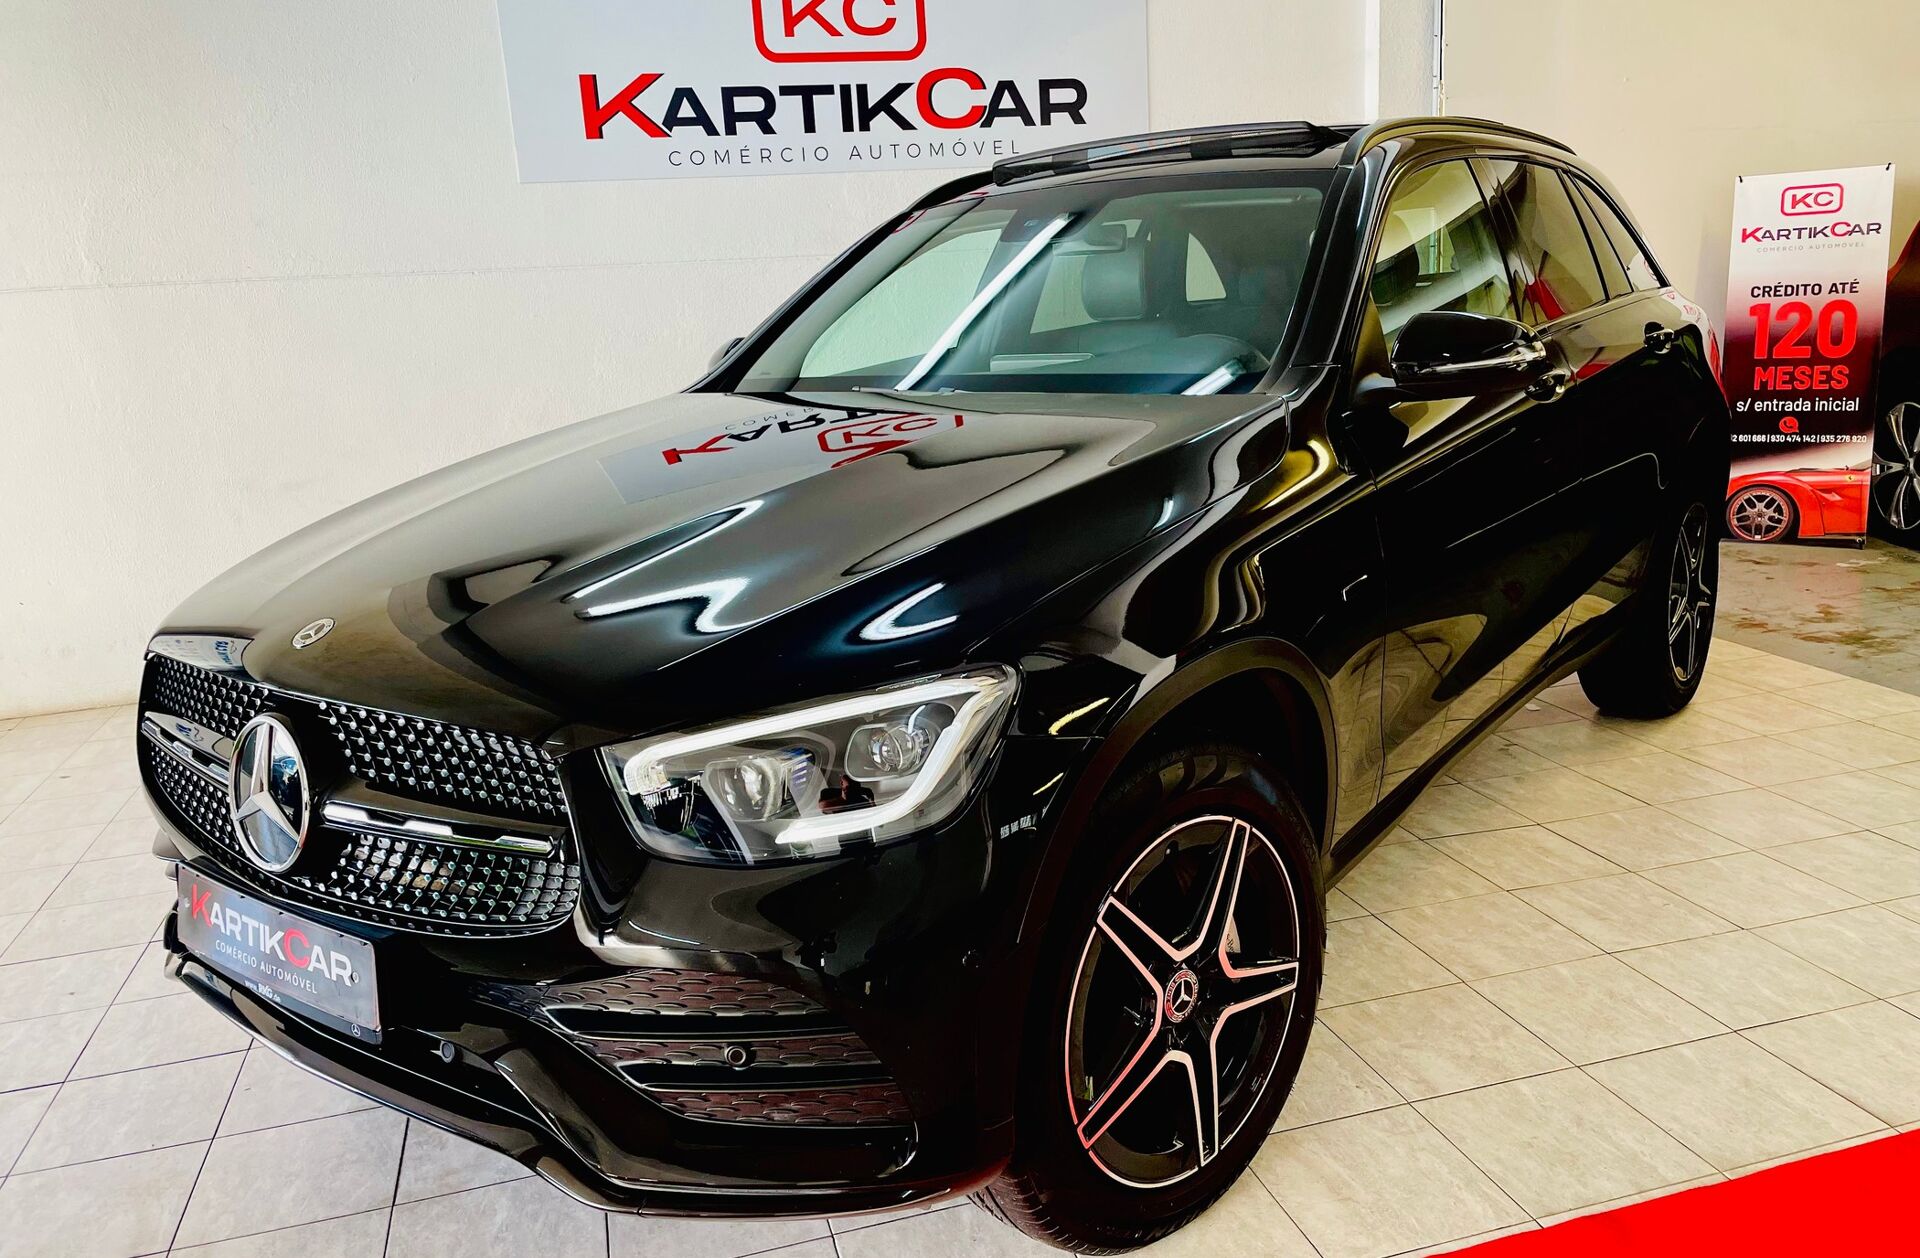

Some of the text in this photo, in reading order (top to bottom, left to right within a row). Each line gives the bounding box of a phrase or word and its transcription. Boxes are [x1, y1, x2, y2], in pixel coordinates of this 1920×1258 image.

[782, 0, 899, 38] KC
[578, 68, 1088, 140] KARTIKCAR
[668, 138, 1020, 166] COMÉRCIO AUTOMÓVEL
[1791, 191, 1834, 209] KC
[1741, 221, 1882, 243] KARTIKCAR
[1750, 279, 1859, 298] CRÉDITO ATÉ
[1749, 299, 1858, 359] 120
[1753, 365, 1849, 390] MESES
[1736, 397, 1859, 412] s/ entrada inicial
[1786, 434, 1801, 442] 474
[1802, 434, 1816, 442] 142
[191, 883, 352, 987] KARTIKCAR
[215, 939, 257, 968] COMÉRCIO
[260, 961, 318, 994] AUTOMÓVEL
